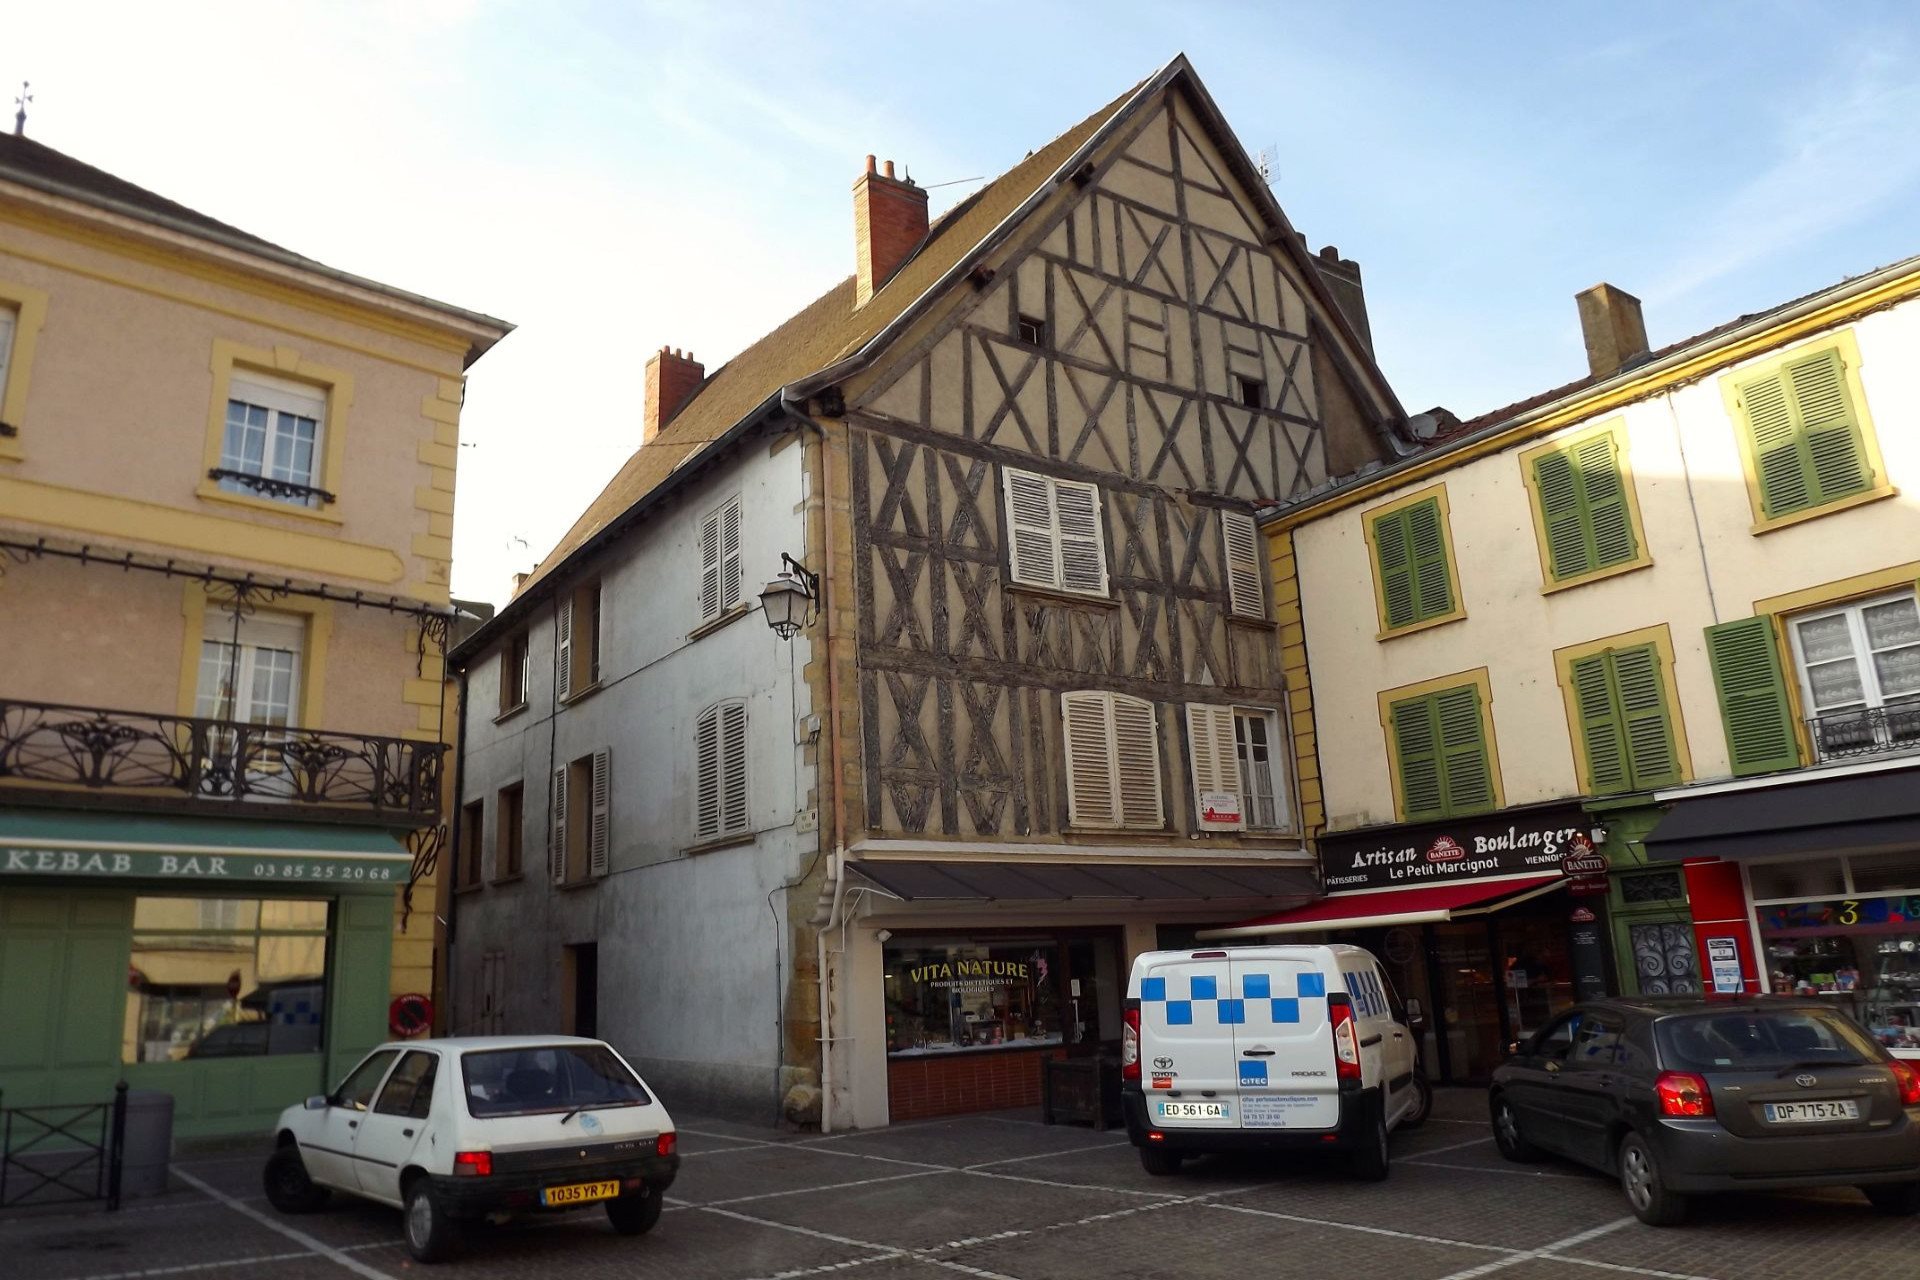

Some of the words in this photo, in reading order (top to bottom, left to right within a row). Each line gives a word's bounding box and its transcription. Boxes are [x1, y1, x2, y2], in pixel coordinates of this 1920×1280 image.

[1351, 846, 1417, 868] Artisan
[1474, 826, 1576, 854] Boulanger
[1430, 850, 1460, 859] BANETTE
[5, 849, 131, 872] KEBAB
[159, 855, 228, 875] BAR
[254, 863, 276, 877] 03
[282, 864, 304, 878] 85
[311, 865, 335, 878] 25
[342, 866, 364, 879] 20
[369, 867, 390, 880] 68
[1389, 867, 1404, 879] Le
[1406, 863, 1434, 877] Petit
[1437, 857, 1499, 874] Marcignot
[1567, 860, 1603, 870] BANETTE
[1326, 874, 1368, 886] PÂTISSERIES
[1839, 900, 1859, 925] 3
[911, 962, 952, 983] VITA
[957, 960, 1029, 978] NATURE
[1776, 1101, 1847, 1119] DP-775-ZA
[550, 1186, 581, 1202] 1035
[583, 1185, 599, 1198] YR
[601, 1182, 615, 1196] 71
